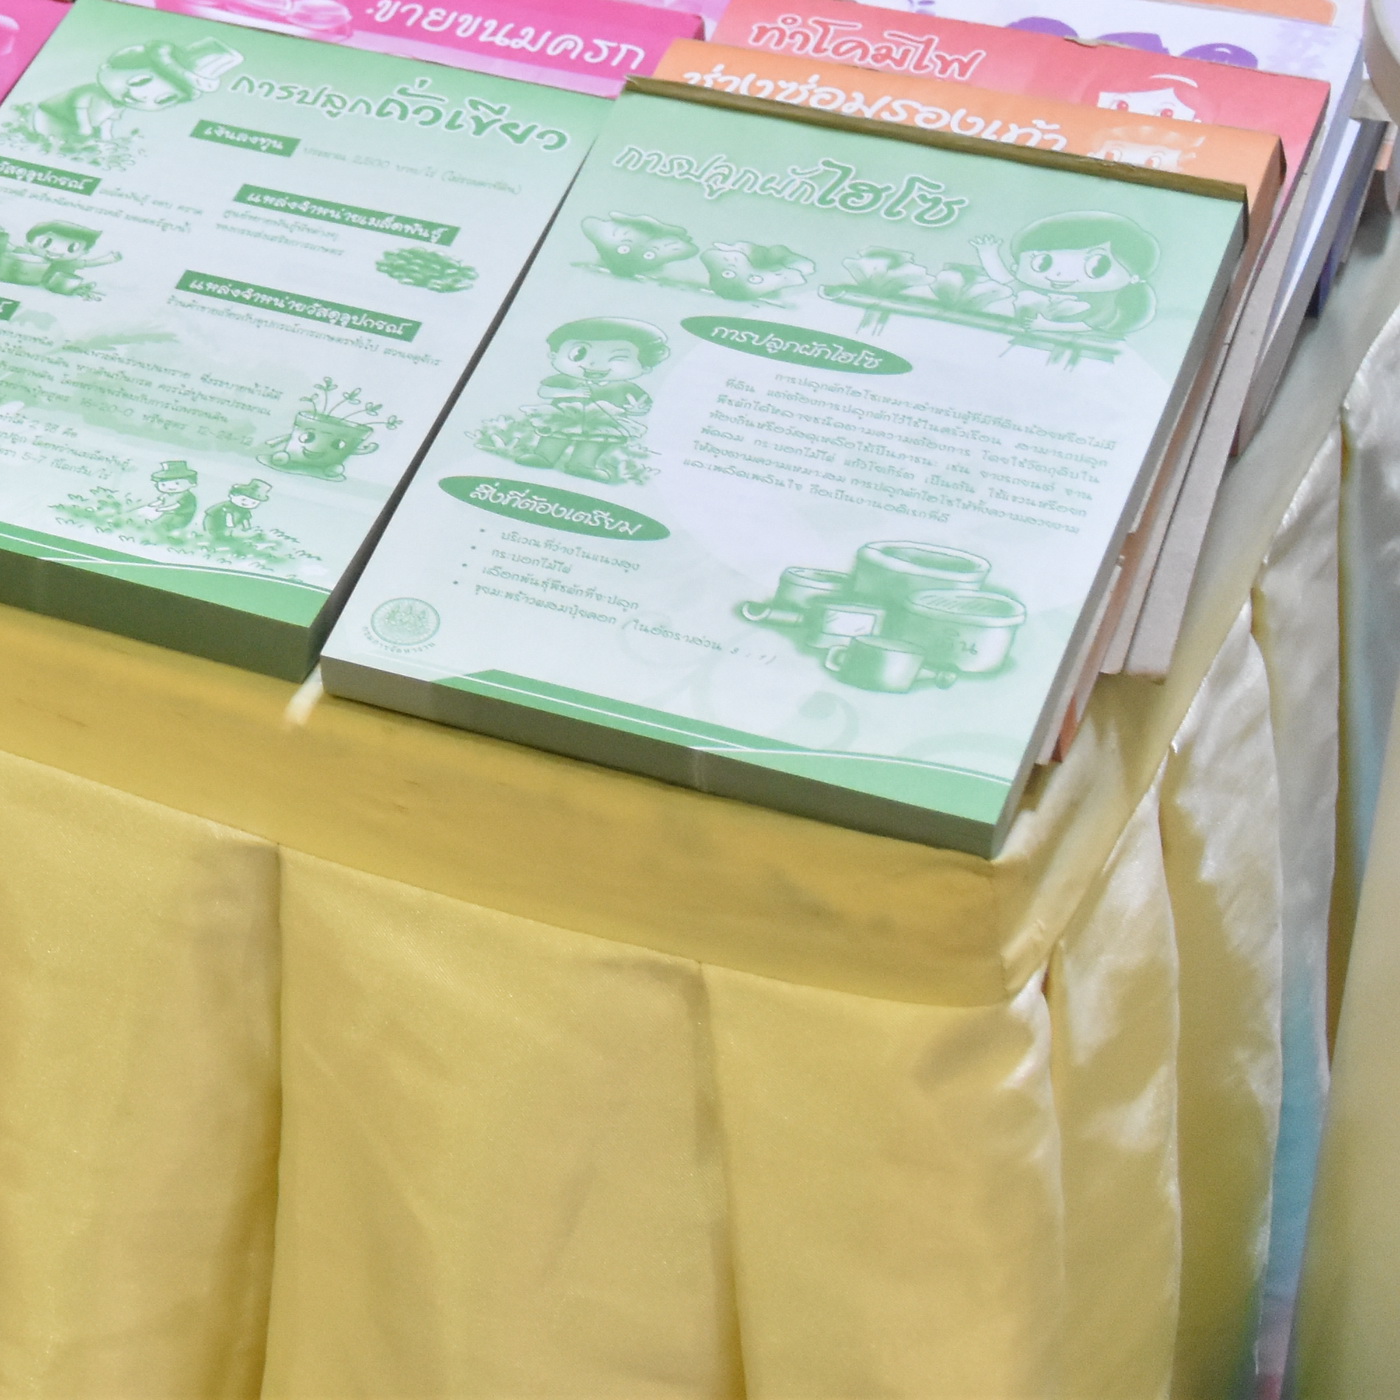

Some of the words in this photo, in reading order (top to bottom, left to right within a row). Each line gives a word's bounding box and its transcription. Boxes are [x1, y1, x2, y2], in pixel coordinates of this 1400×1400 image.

[750, 14, 988, 81] ทำโคมไฟ
[228, 64, 571, 157] การปลูกถั่วเขียว
[200, 122, 288, 154] เงินลงทุน
[613, 140, 973, 229] การปลูกผักไฮโซ
[244, 183, 447, 247] แหล่งจำหน่ายเมล็ดพันธุ์
[186, 274, 408, 341] แหล่งจำหน่ายวัสดุอุปกรณ์
[710, 320, 886, 373] การปลูกผักไฮโซ
[724, 376, 759, 392] ที่ดิน
[1012, 440, 1109, 470] สามารถปลูก
[19, 450, 48, 465] 5-7
[682, 455, 805, 491] และเพลิดเพลินใจ
[468, 480, 644, 541] สิ่งที่ต้องเตรียม
[489, 546, 574, 575] กระบอกไม้ไผ่
[496, 528, 644, 575] บริเวณที่ว่างในแนวสูง
[478, 563, 642, 614] เลือกพันธุ์พืชผักที่จะปลูก
[362, 626, 436, 654] กรมการจัดหางาน
